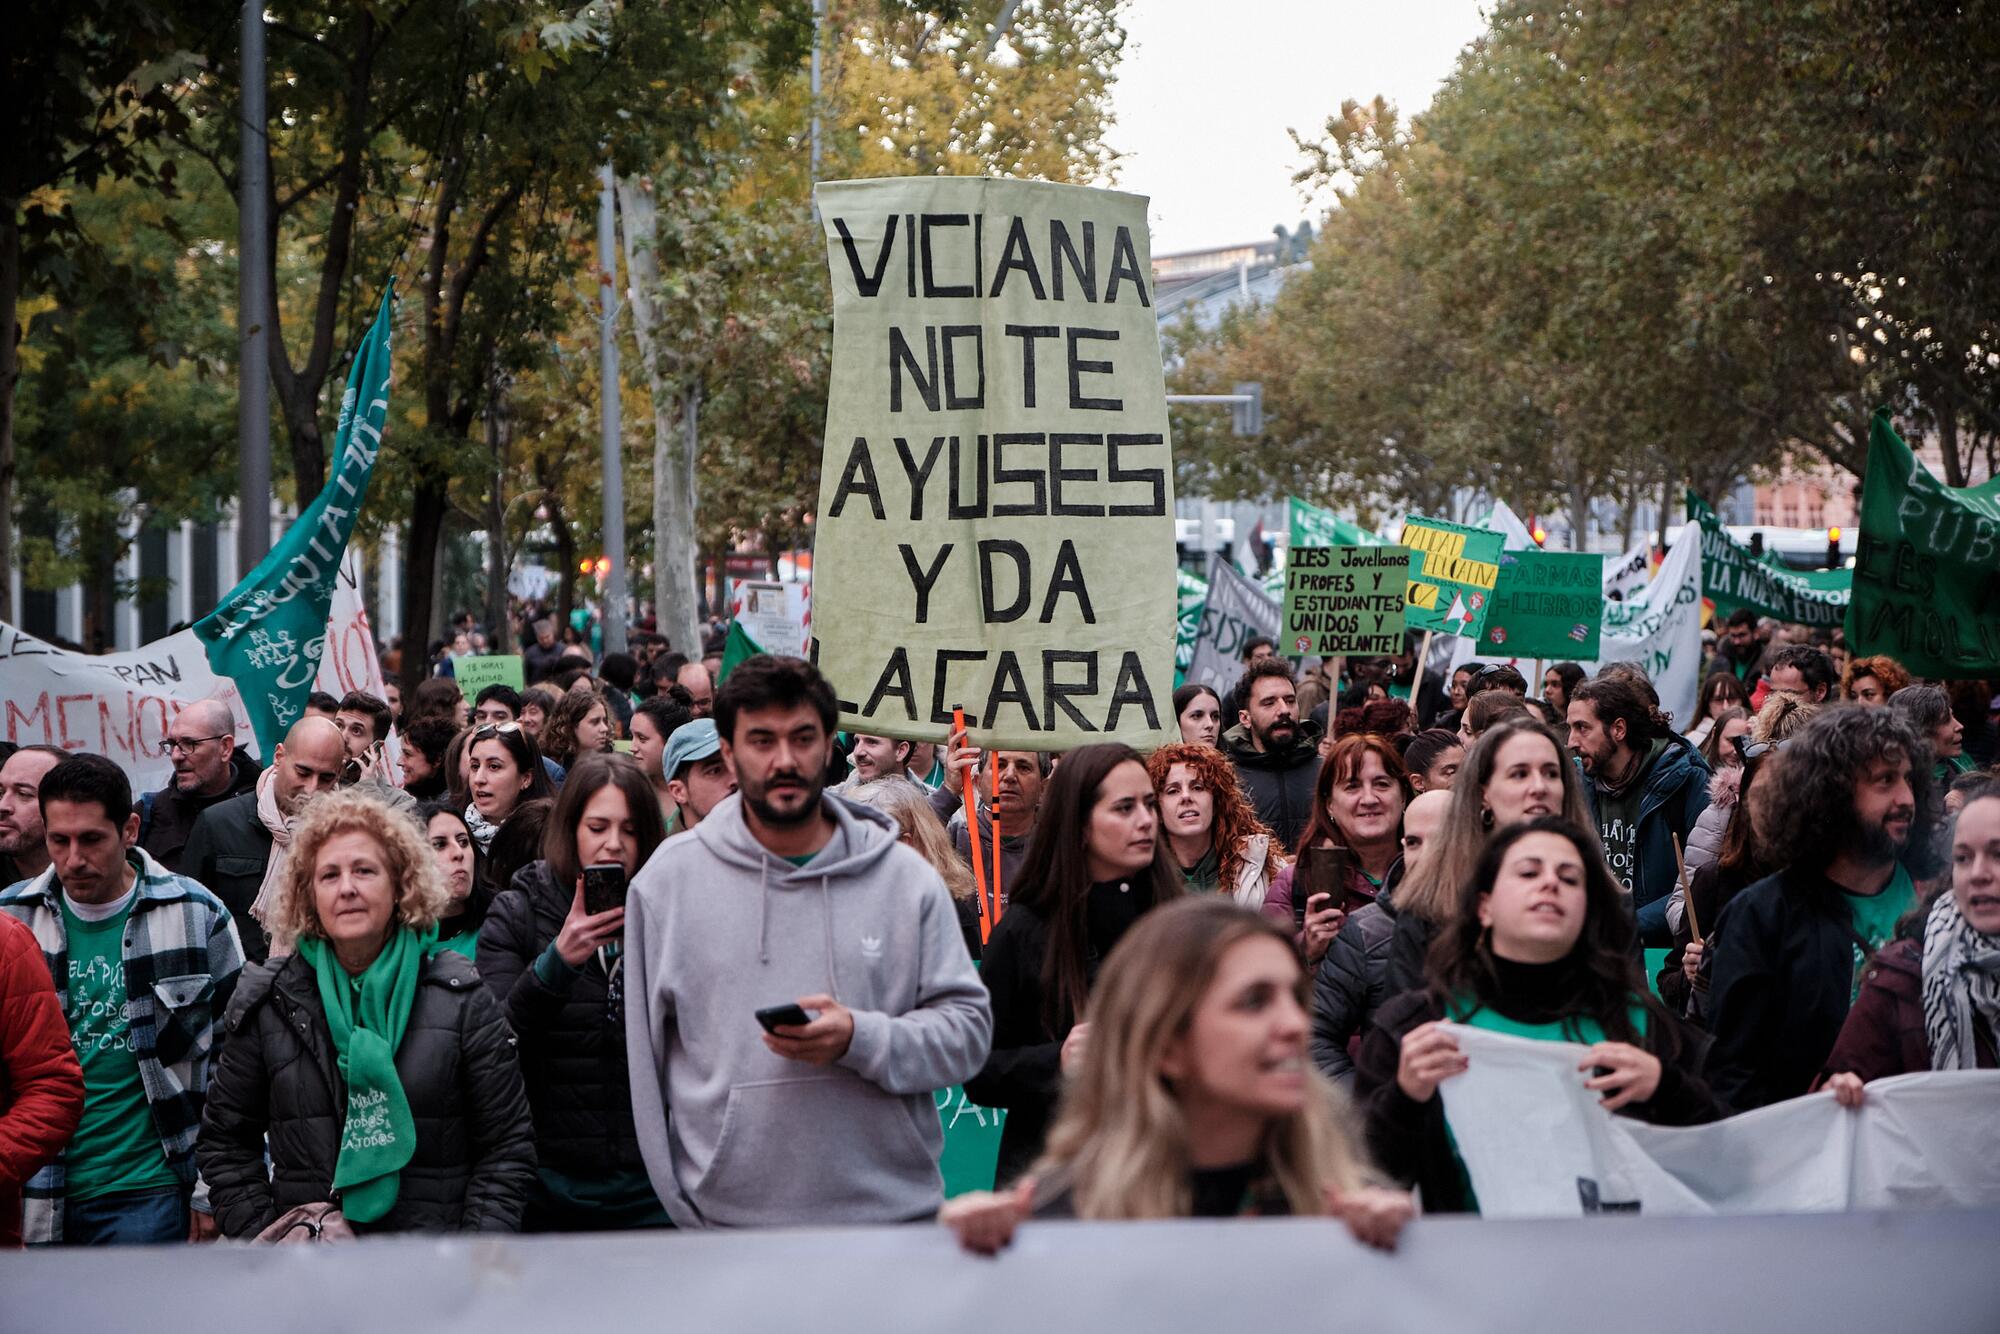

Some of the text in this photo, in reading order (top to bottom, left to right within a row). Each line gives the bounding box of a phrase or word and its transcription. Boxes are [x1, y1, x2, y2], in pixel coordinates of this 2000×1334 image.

[833, 214, 1150, 307] VICIANA
[889, 324, 1123, 412] NO TE
[829, 432, 1166, 520] AYUSES
[1290, 546, 1410, 568] IES Jovellanos
[898, 539, 1096, 624] Y DA
[1373, 572, 1383, 591] Y
[1294, 595, 1405, 613] ESTUDIANTES
[1290, 613, 1384, 634] UNIDOS Y
[1318, 633, 1400, 654] ADELANTE!
